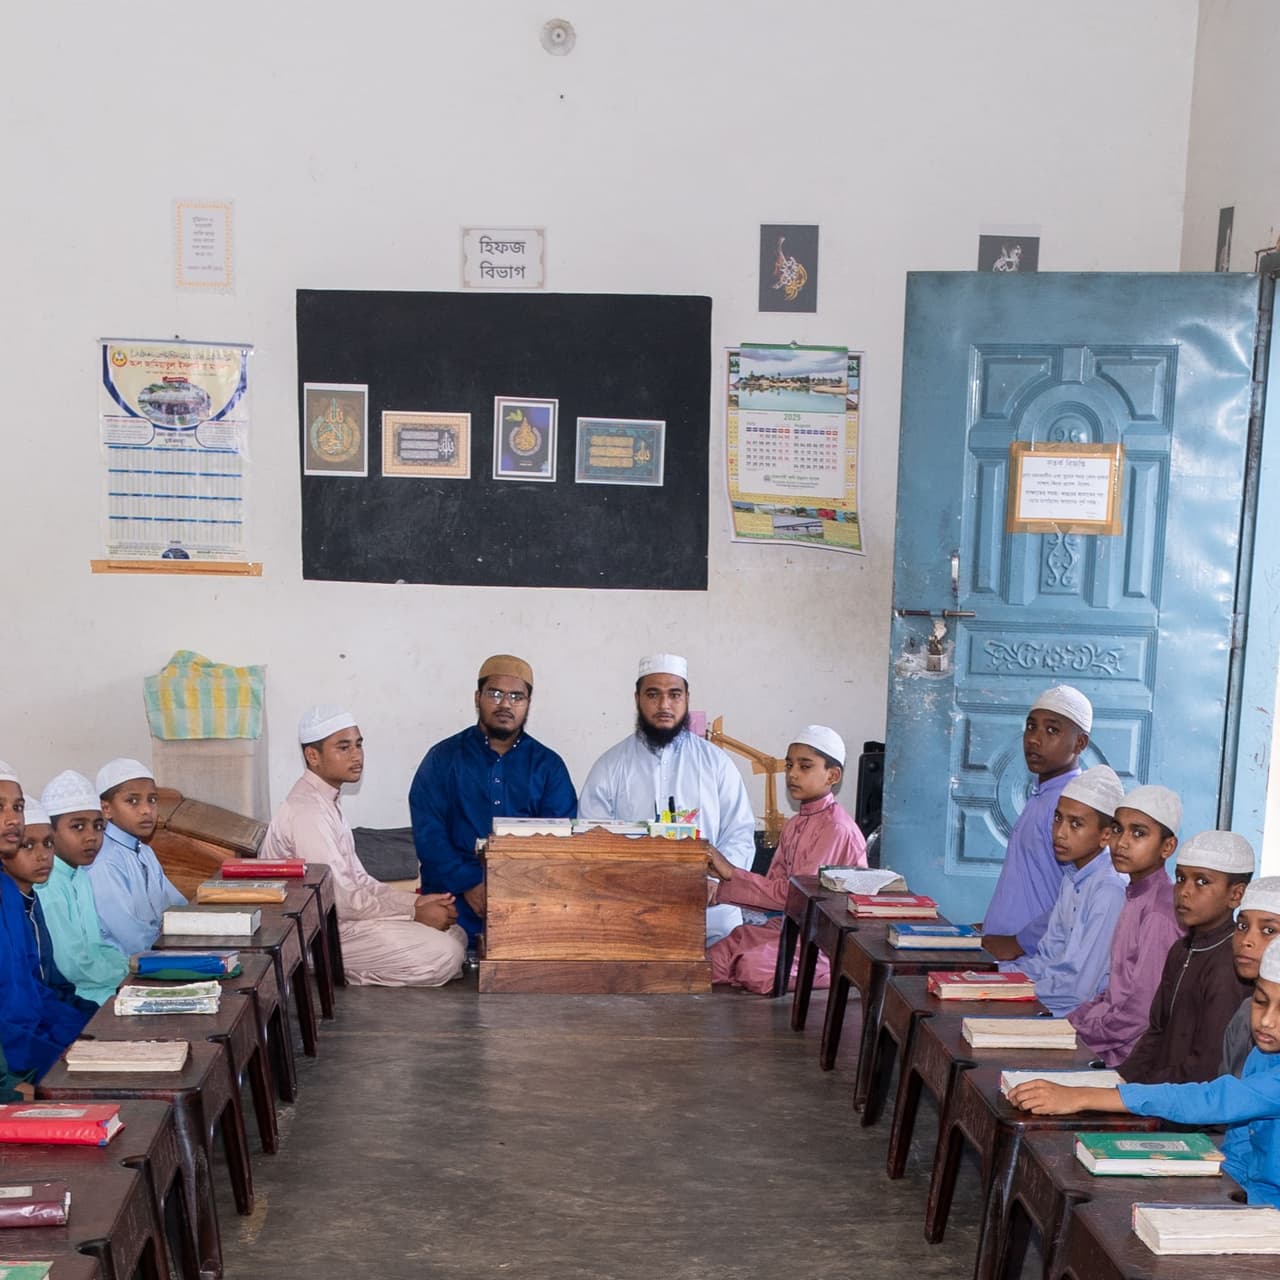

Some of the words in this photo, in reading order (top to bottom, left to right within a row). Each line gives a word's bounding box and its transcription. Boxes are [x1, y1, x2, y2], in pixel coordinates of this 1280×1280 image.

[478, 235, 526, 255] হিফজ
[479, 260, 526, 280] বিভাগ
[784, 413, 801, 421] 2025
